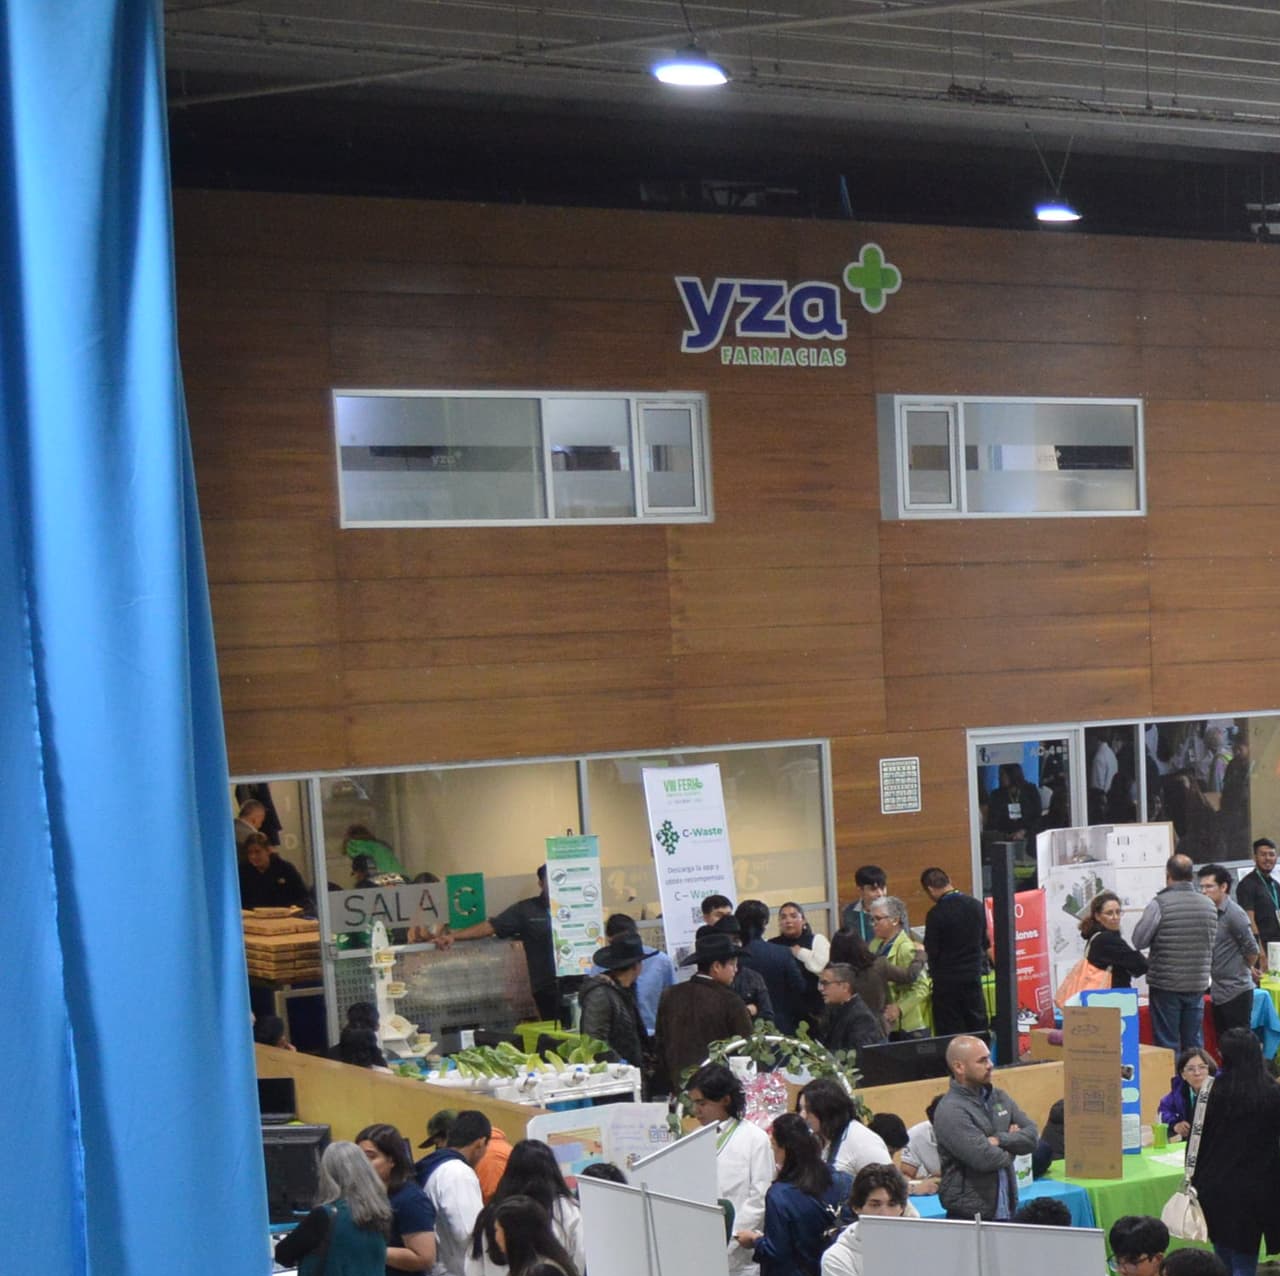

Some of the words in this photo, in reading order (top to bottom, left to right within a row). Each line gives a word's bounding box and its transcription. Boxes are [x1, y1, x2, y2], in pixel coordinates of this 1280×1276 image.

[675, 276, 847, 353] yza
[721, 347, 847, 366] FARMACIAS
[682, 827, 723, 838] C-Waste
[344, 889, 439, 926] SALA
[454, 886, 478, 916] C
